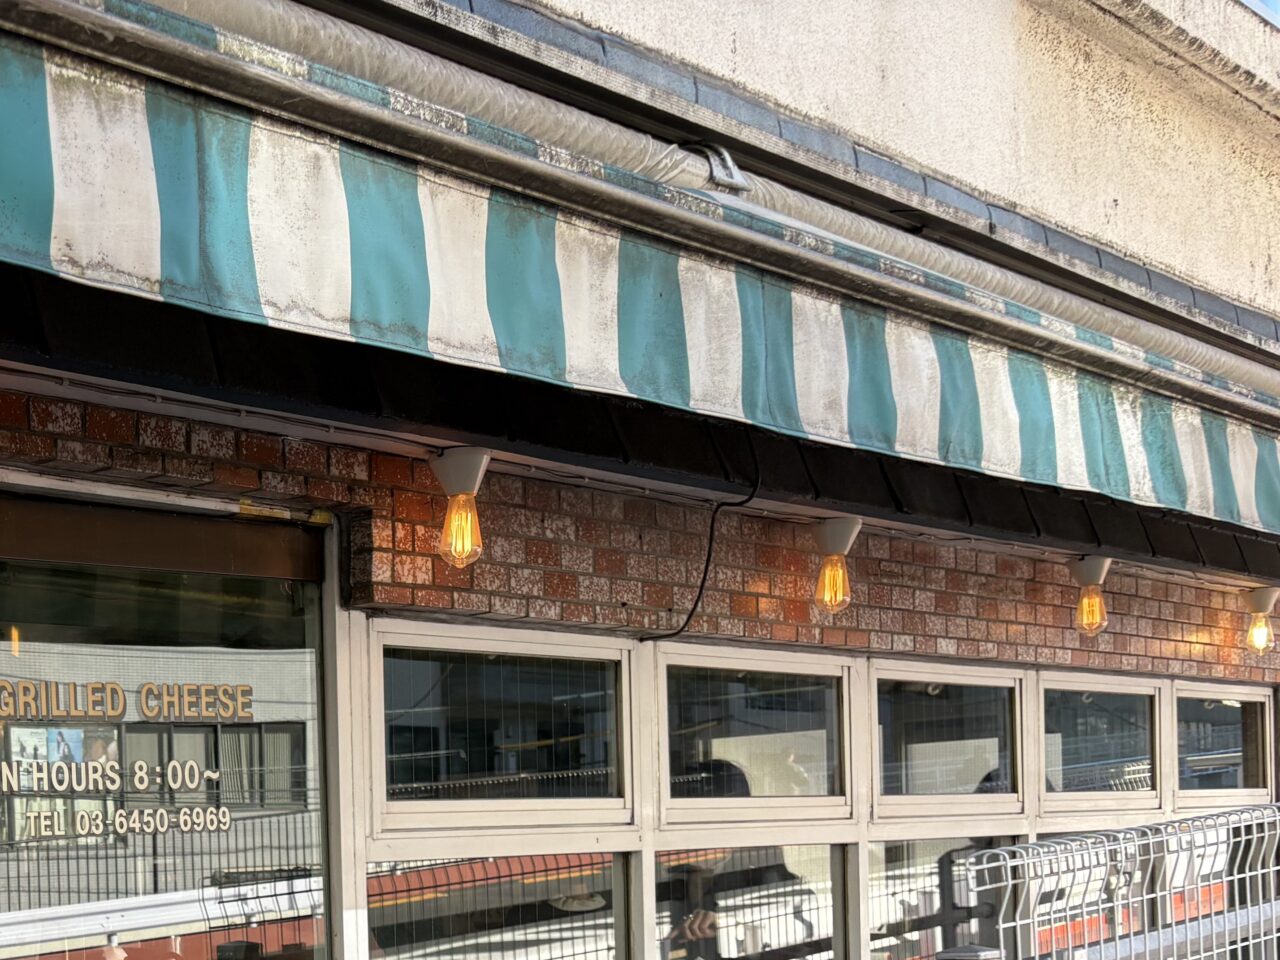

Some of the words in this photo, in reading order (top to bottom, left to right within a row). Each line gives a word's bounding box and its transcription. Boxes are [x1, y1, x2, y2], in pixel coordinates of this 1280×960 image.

[140, 682, 254, 720] CHEESE
[32, 761, 120, 792] HOURS
[26, 811, 66, 836] TEL
[76, 807, 231, 834] 03-6450-6969
